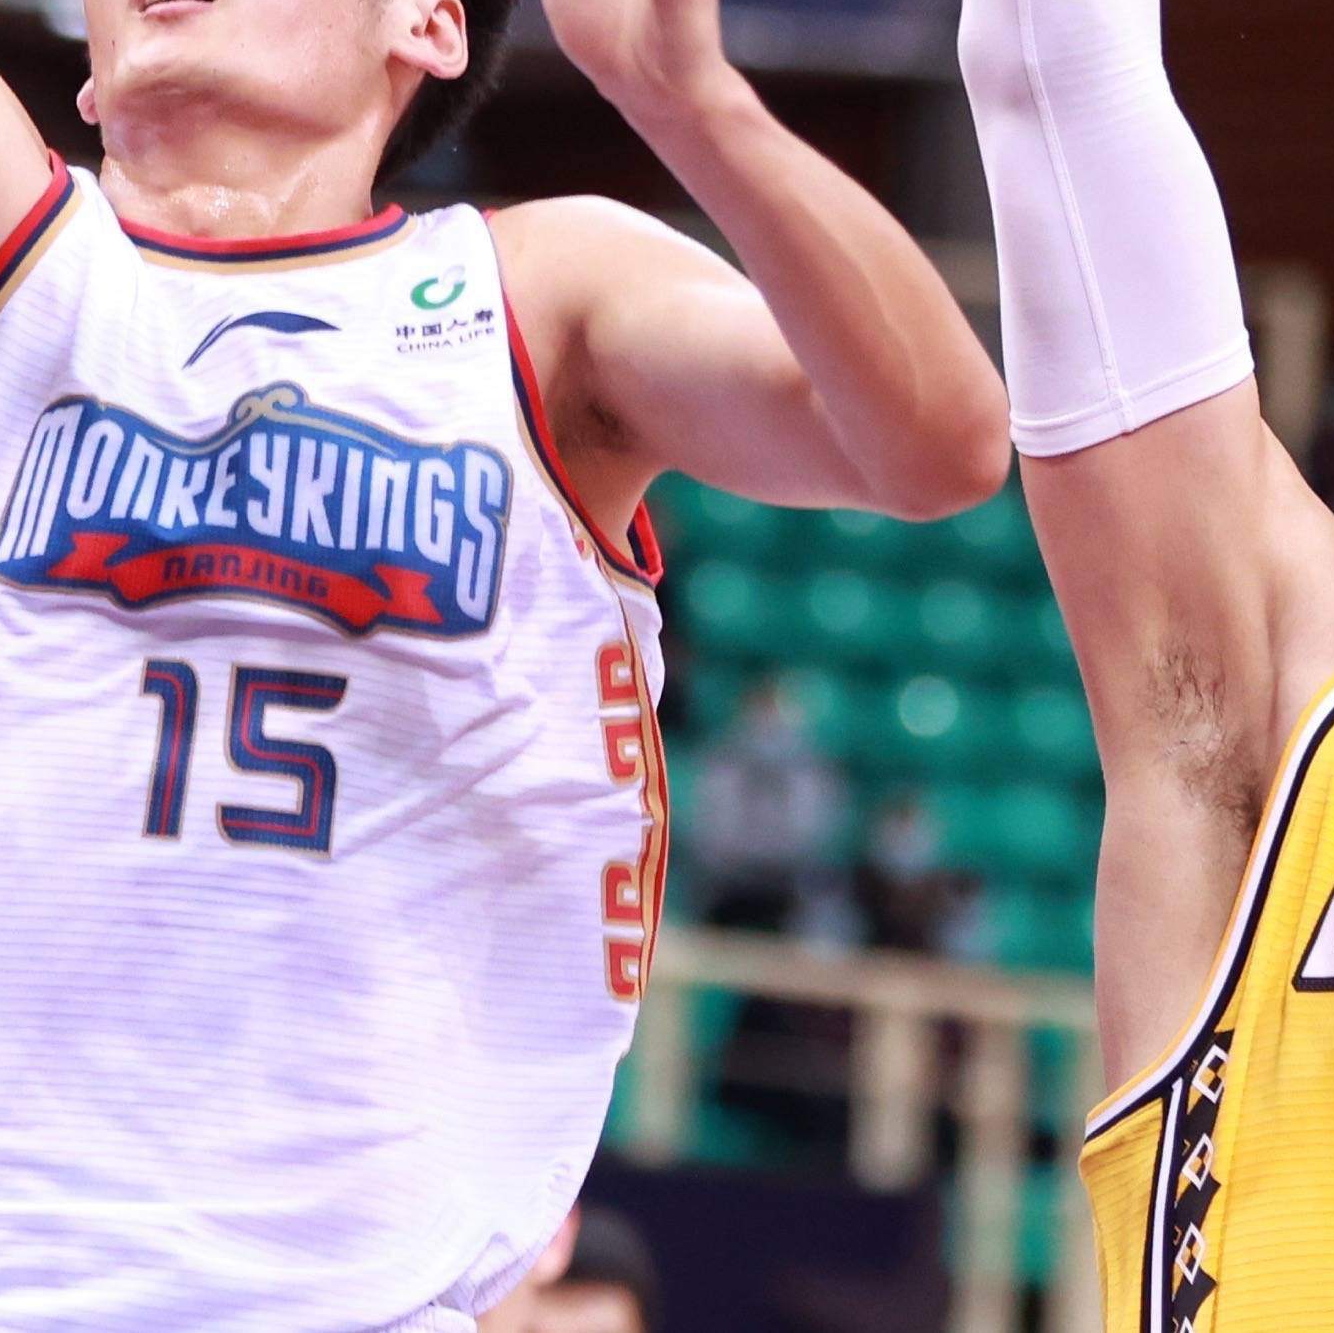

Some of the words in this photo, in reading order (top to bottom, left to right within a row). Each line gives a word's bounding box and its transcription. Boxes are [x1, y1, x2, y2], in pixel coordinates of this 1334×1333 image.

[396, 339, 453, 353] CHINA
[163, 553, 330, 598] NANJING
[139, 657, 349, 859] 15
